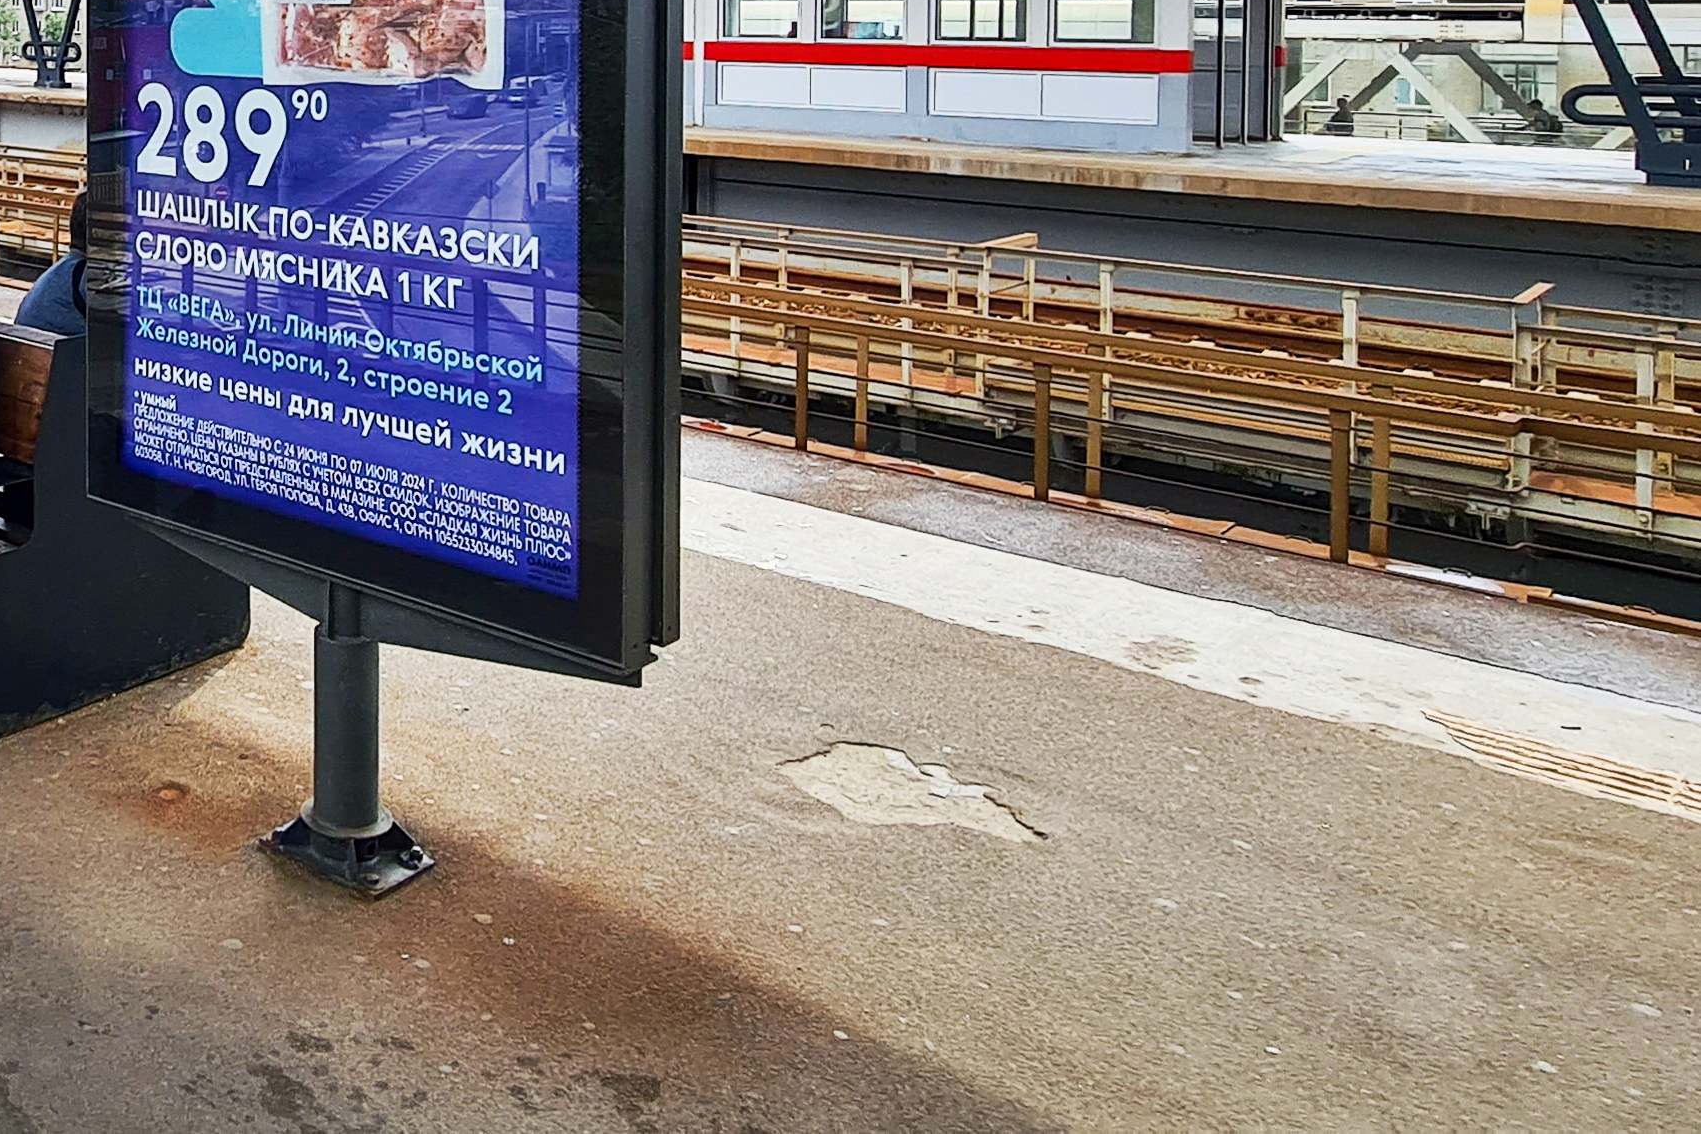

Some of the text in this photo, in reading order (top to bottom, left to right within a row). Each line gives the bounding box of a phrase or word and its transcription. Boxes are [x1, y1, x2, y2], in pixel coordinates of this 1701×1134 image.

[136, 82, 328, 187] 289 90
[135, 231, 464, 309] СЛОВО МЯСНИКА 1 КГ
[137, 189, 539, 270] ШАШЛЫК ПО-КАВКАЗСКИ
[136, 285, 543, 382] ТЦ «ВЕГА», ул. Линии Октябрьской
[136, 316, 513, 415] Железной Дороги, 2, строение 2
[134, 357, 566, 475] низкие цены для лучшей жизни
[134, 403, 572, 528] ПРЕДЛОЖЕНИЕ ДЕЙСТВИТЕЛЬНО С 24 ИЮНЯ ПО 07 ИЮЛЯ 2024 Г. КОЛИЧЕСТВО ТОВАРА
[134, 430, 164, 450] МОЖЕТ
[165, 439, 219, 466] ОТЛИЧАТЬСЯ
[220, 455, 233, 469] ОТ
[234, 458, 320, 494] ПРЕДСТАВЛЕННЫХ
[322, 482, 329, 496] В
[389, 501, 417, 521] ООО
[418, 510, 477, 537] «СЛАДКАЯ
[480, 525, 523, 549] ЖИЗНЬ
[525, 537, 572, 562] ПЛЮС»
[184, 458, 232, 485] НОВГОРОД
[250, 475, 278, 496] ГЕРОЯ
[359, 508, 392, 529] ОФИС
[393, 518, 403, 534] 4,
[403, 520, 433, 541] ОГРН
[434, 528, 518, 566] 1055233034845.
[190, 431, 215, 450] ЦЕНЫ
[217, 439, 258, 462] УКАЗАНЫ
[259, 451, 266, 464] В
[267, 453, 301, 474] РУБЛЯХ
[302, 462, 311, 477] С
[312, 465, 352, 488] УЧЕТОМ
[355, 476, 381, 495] ВСЕХ
[434, 496, 520, 532] ИЗОБРАЖЕНИЕ
[523, 519, 572, 546] ТОВАРА
